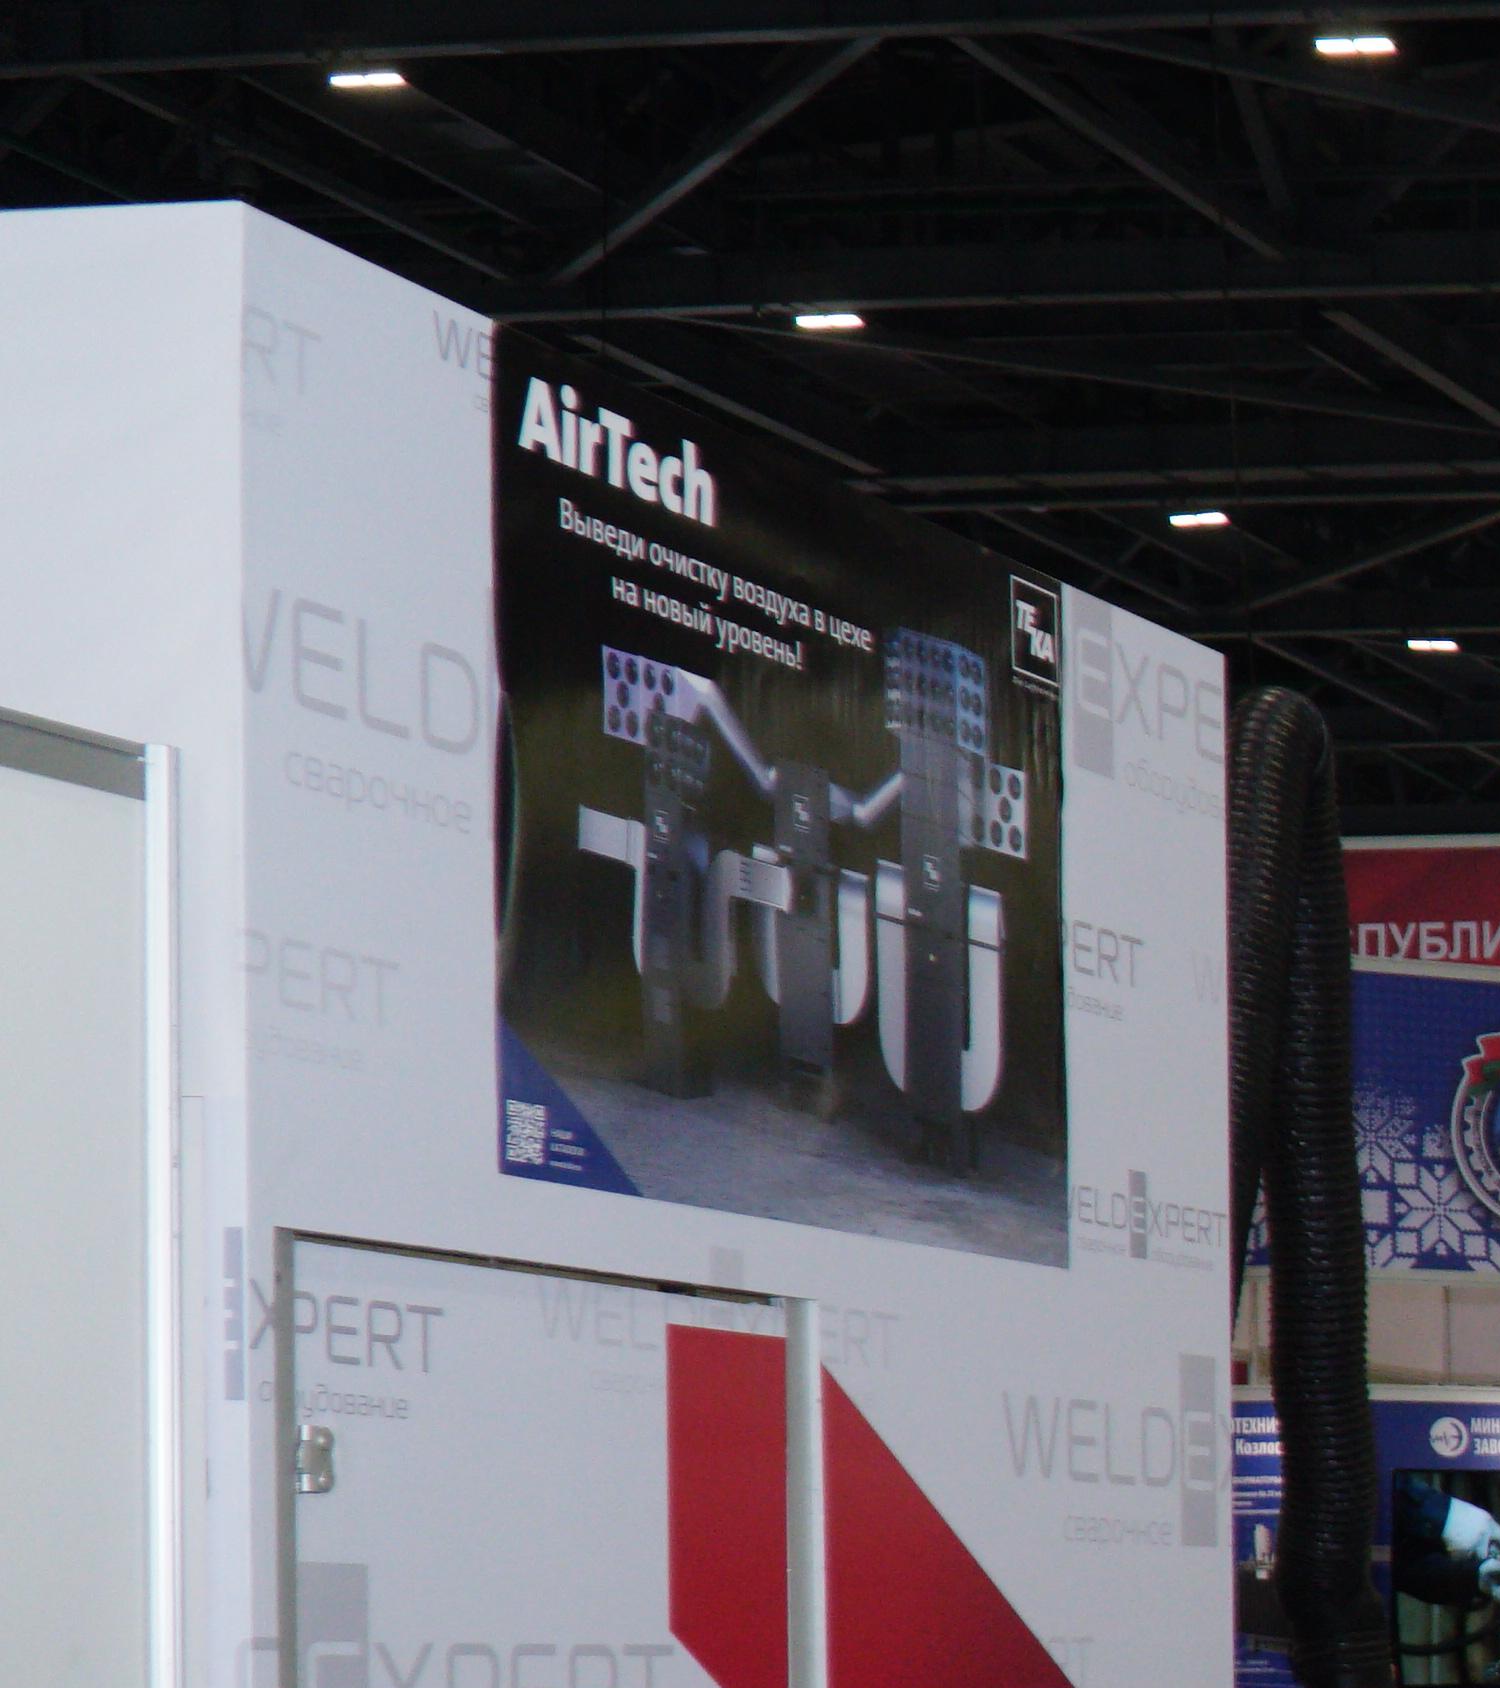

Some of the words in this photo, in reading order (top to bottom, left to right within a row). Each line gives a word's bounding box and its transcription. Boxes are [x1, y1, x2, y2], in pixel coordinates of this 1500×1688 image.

[518, 376, 717, 527] AirTech
[559, 497, 646, 562] Выведи
[649, 541, 730, 594] очистку
[732, 574, 810, 628] воздуха
[814, 609, 826, 632] в
[829, 616, 873, 652] цехе
[611, 576, 639, 607] на
[643, 587, 711, 635] новый
[715, 614, 804, 670] уровень!
[286, 748, 472, 834] сварочное
